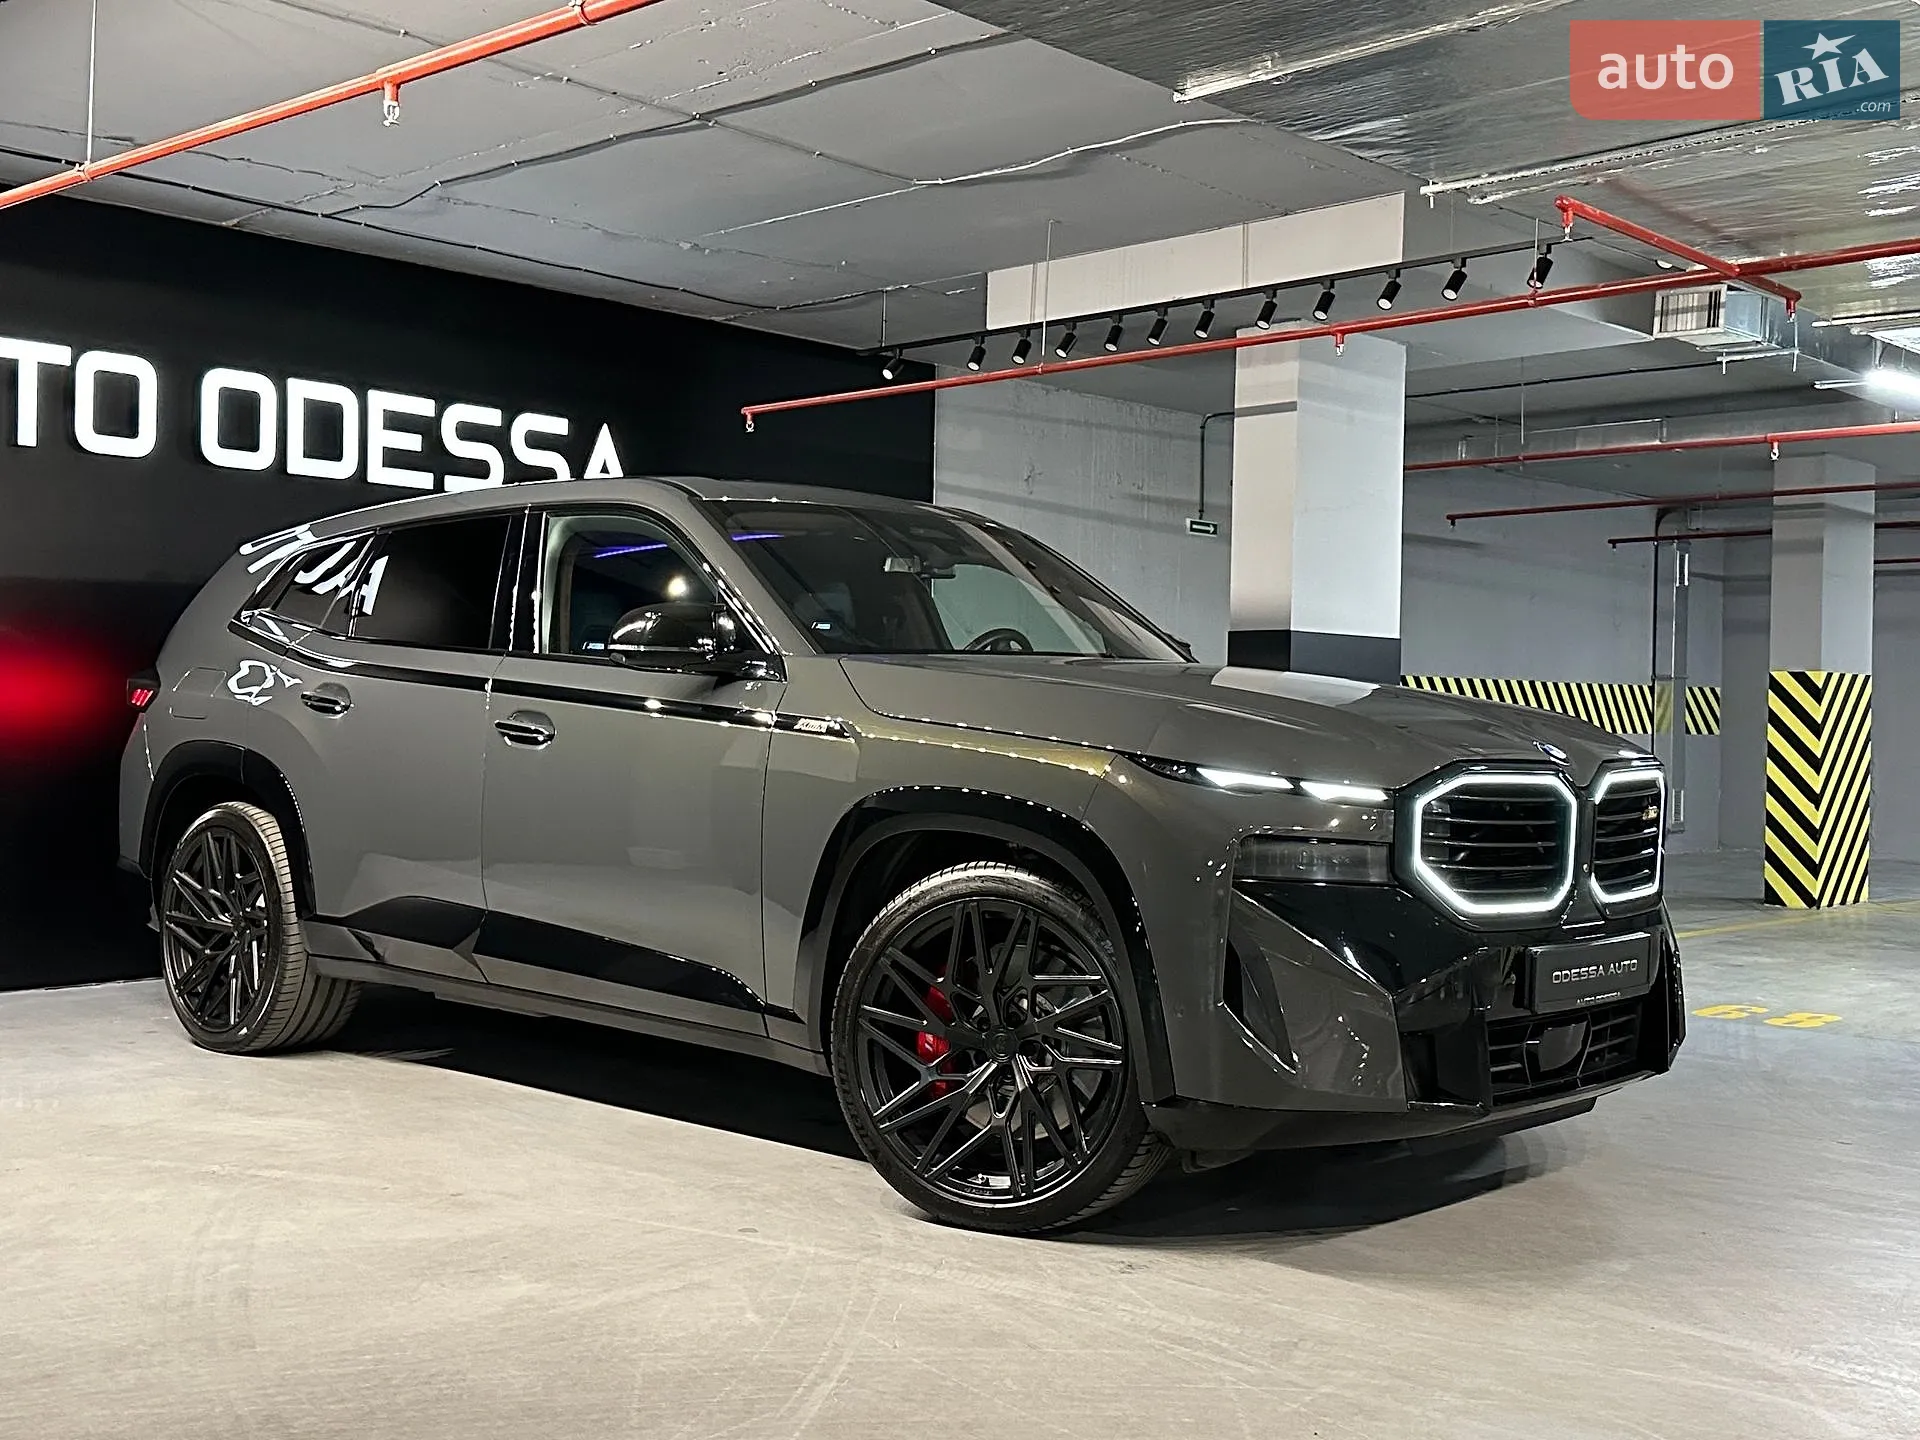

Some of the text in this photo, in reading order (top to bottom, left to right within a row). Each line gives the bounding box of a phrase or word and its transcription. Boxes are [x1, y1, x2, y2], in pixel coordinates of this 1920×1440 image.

[200, 366, 625, 494] ODESSA
[1552, 959, 1638, 984] ODESSA AUTO
[1691, 1004, 1843, 1028] 68
